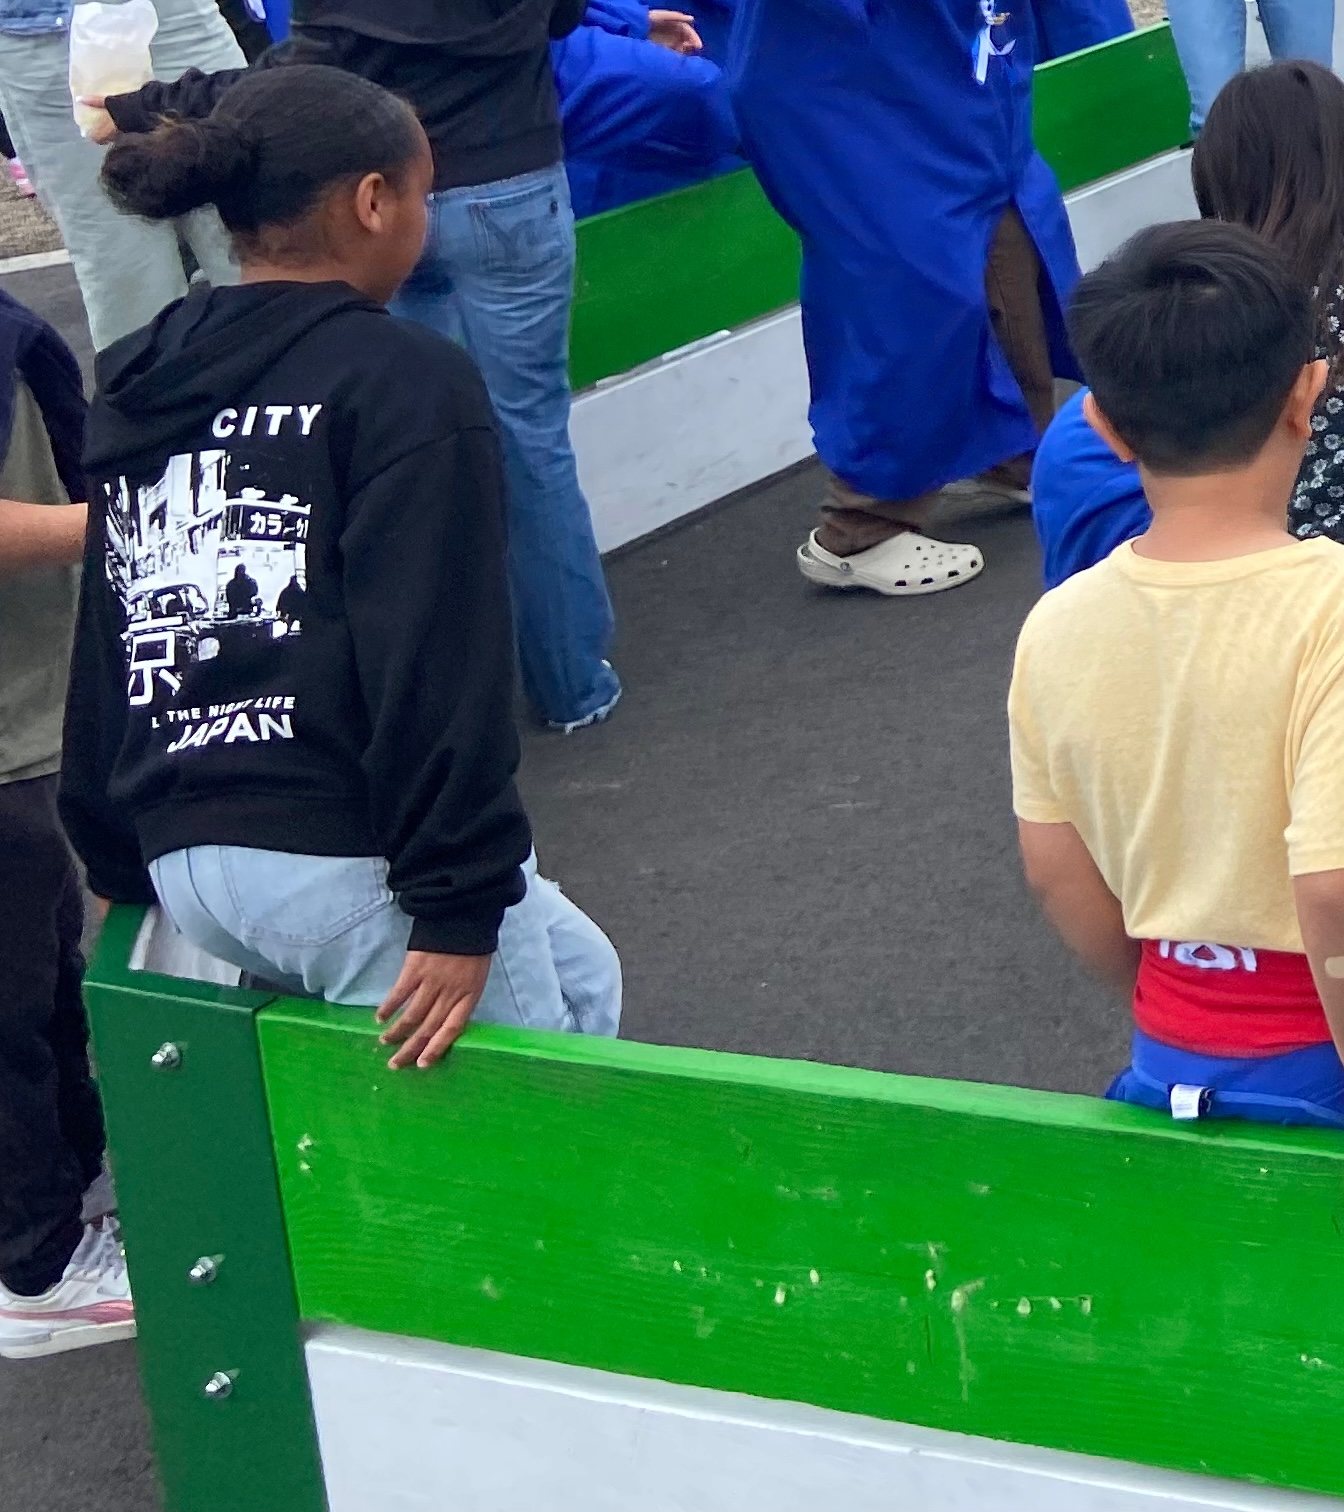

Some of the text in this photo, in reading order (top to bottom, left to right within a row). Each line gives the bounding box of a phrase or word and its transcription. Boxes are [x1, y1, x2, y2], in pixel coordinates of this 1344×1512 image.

[211, 404, 323, 438] CITY
[167, 707, 201, 723] THE
[166, 713, 295, 754] JAPAN
